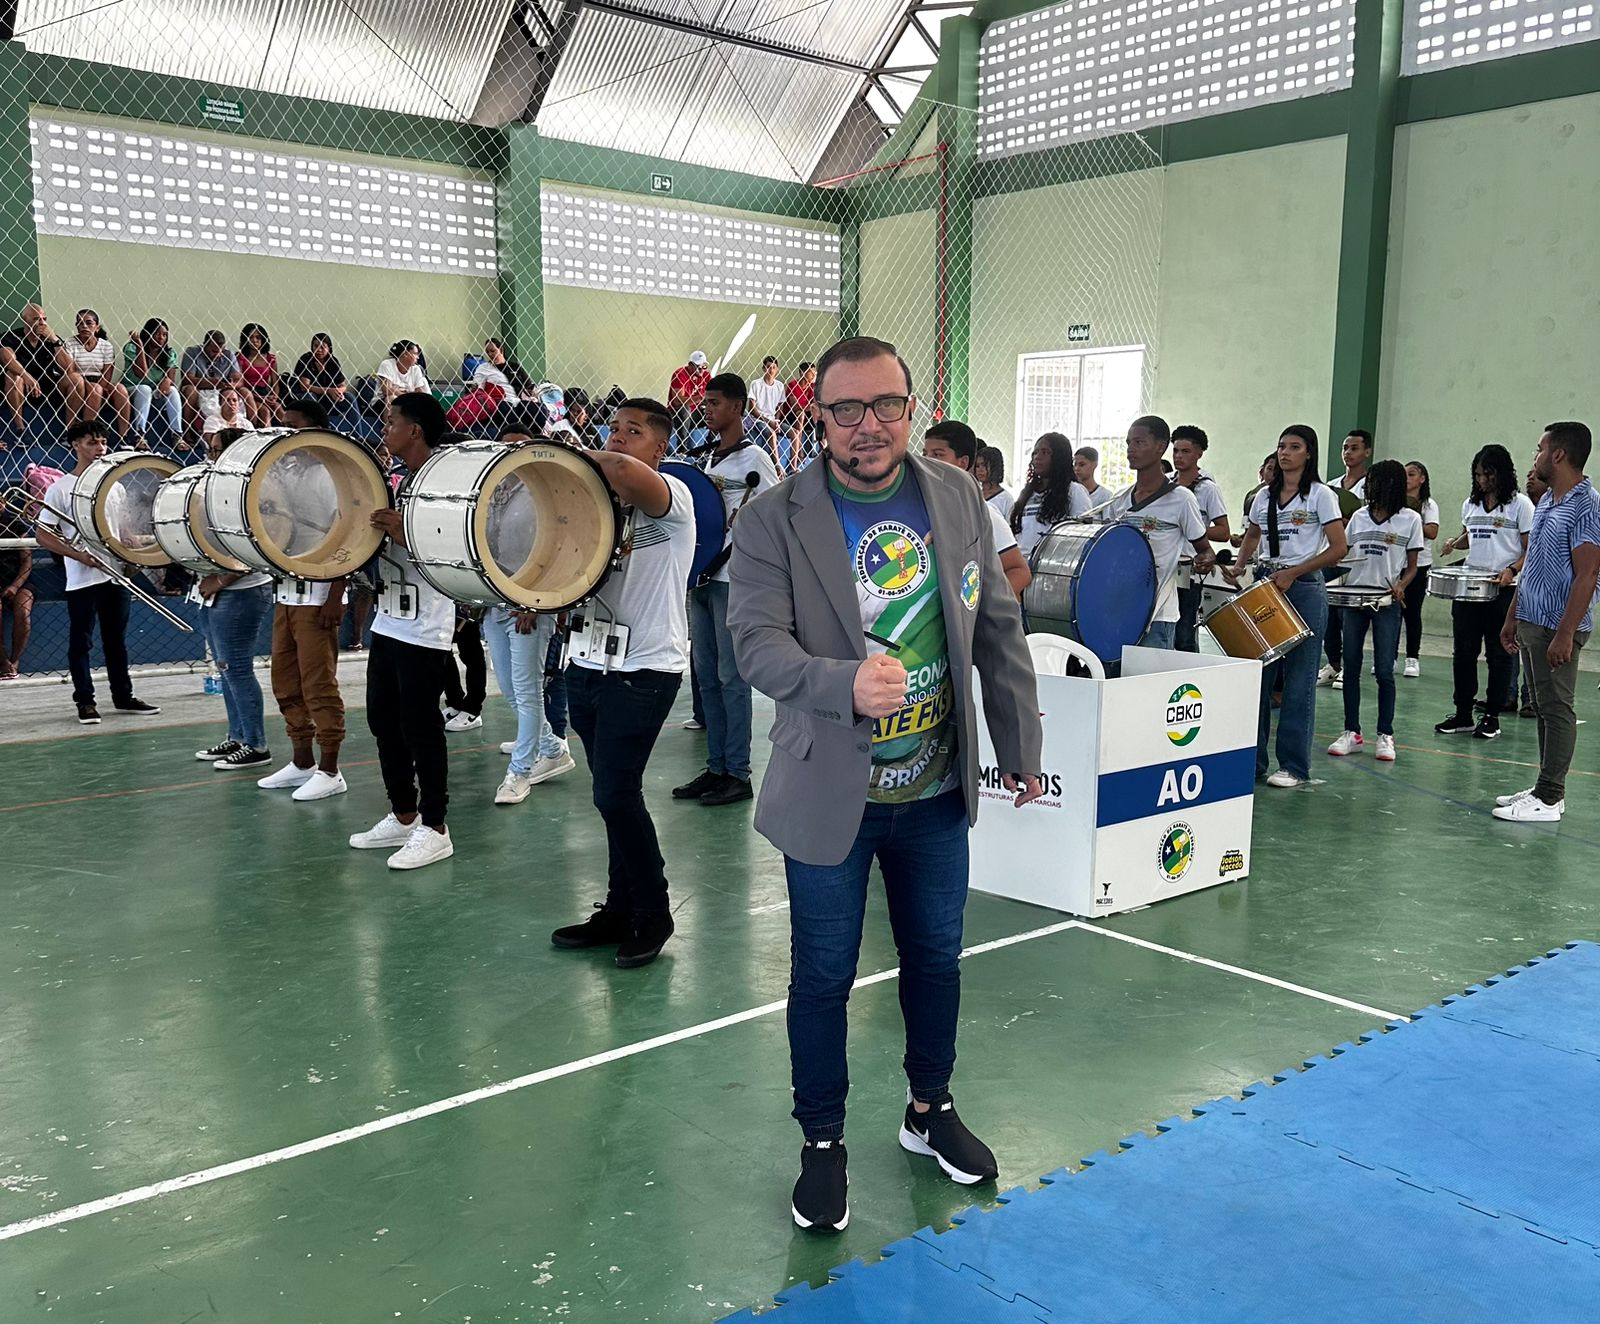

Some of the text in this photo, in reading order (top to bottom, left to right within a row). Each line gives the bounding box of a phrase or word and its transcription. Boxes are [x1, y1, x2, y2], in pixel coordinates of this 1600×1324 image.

[867, 530, 877, 539] DE
[906, 532, 916, 542] DE
[900, 683, 942, 708] ANO DE
[872, 707, 914, 738] ATE
[1166, 702, 1202, 724] CBKO
[879, 738, 939, 790] BRANCA
[1156, 764, 1203, 807] AO
